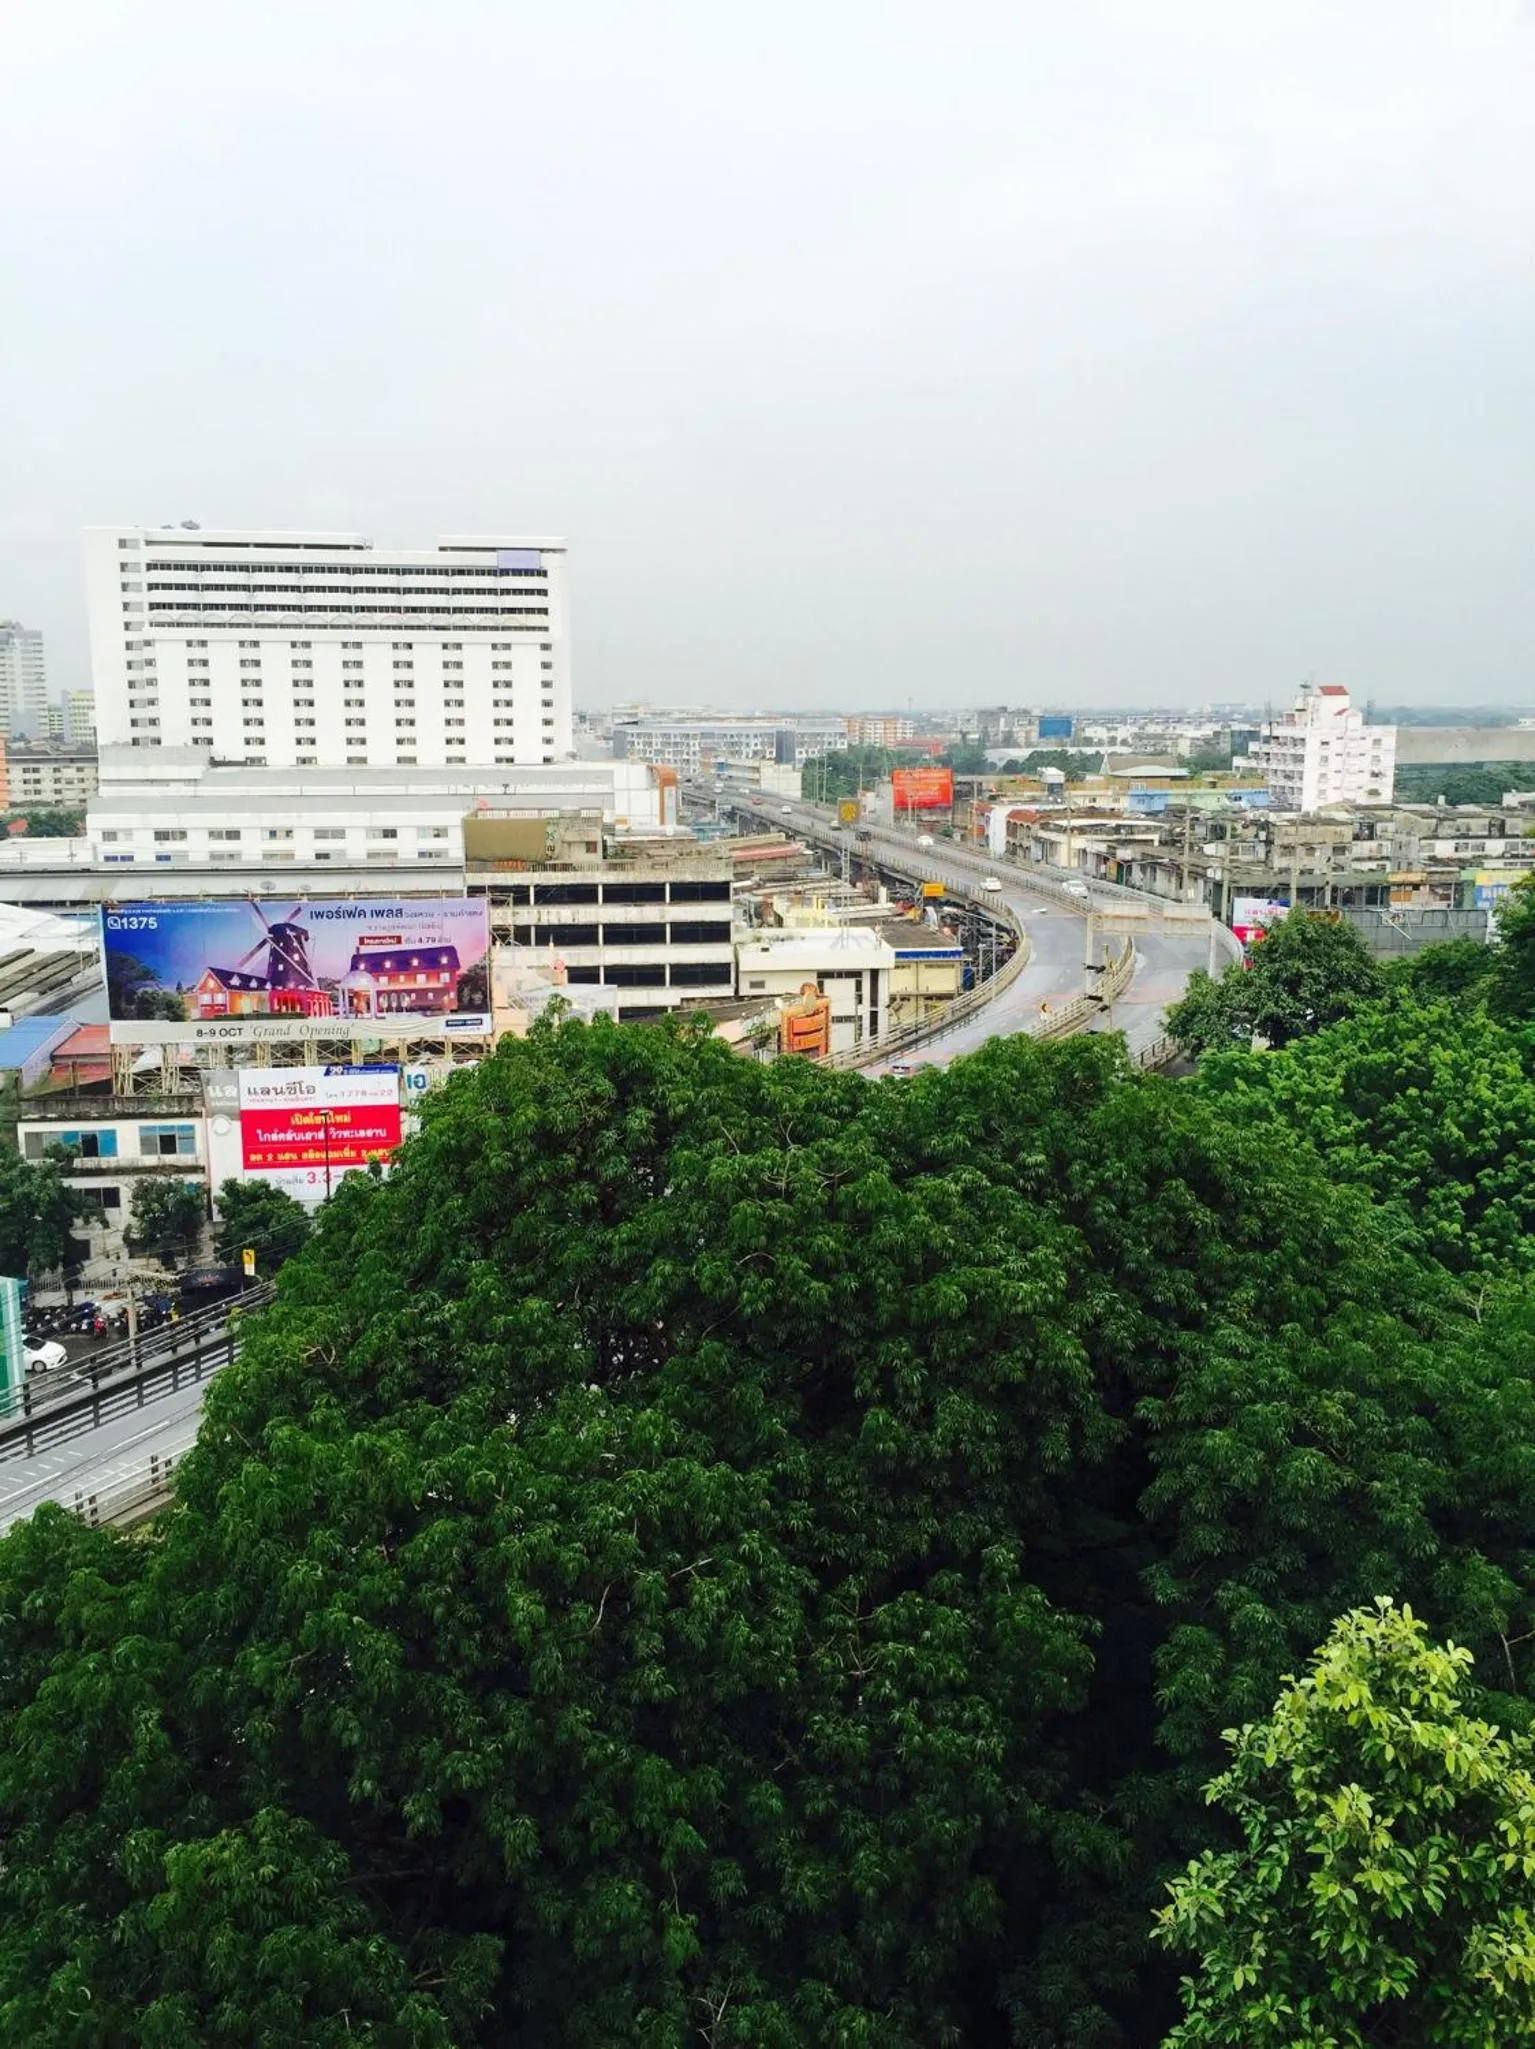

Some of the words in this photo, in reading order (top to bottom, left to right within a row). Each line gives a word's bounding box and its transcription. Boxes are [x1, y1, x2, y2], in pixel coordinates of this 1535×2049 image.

[310, 906, 367, 920] เพอร์เฟค
[371, 908, 404, 920] เพลส
[121, 917, 158, 930] 1375
[195, 1028, 217, 1038] 8-9
[219, 1027, 243, 1037] OCT
